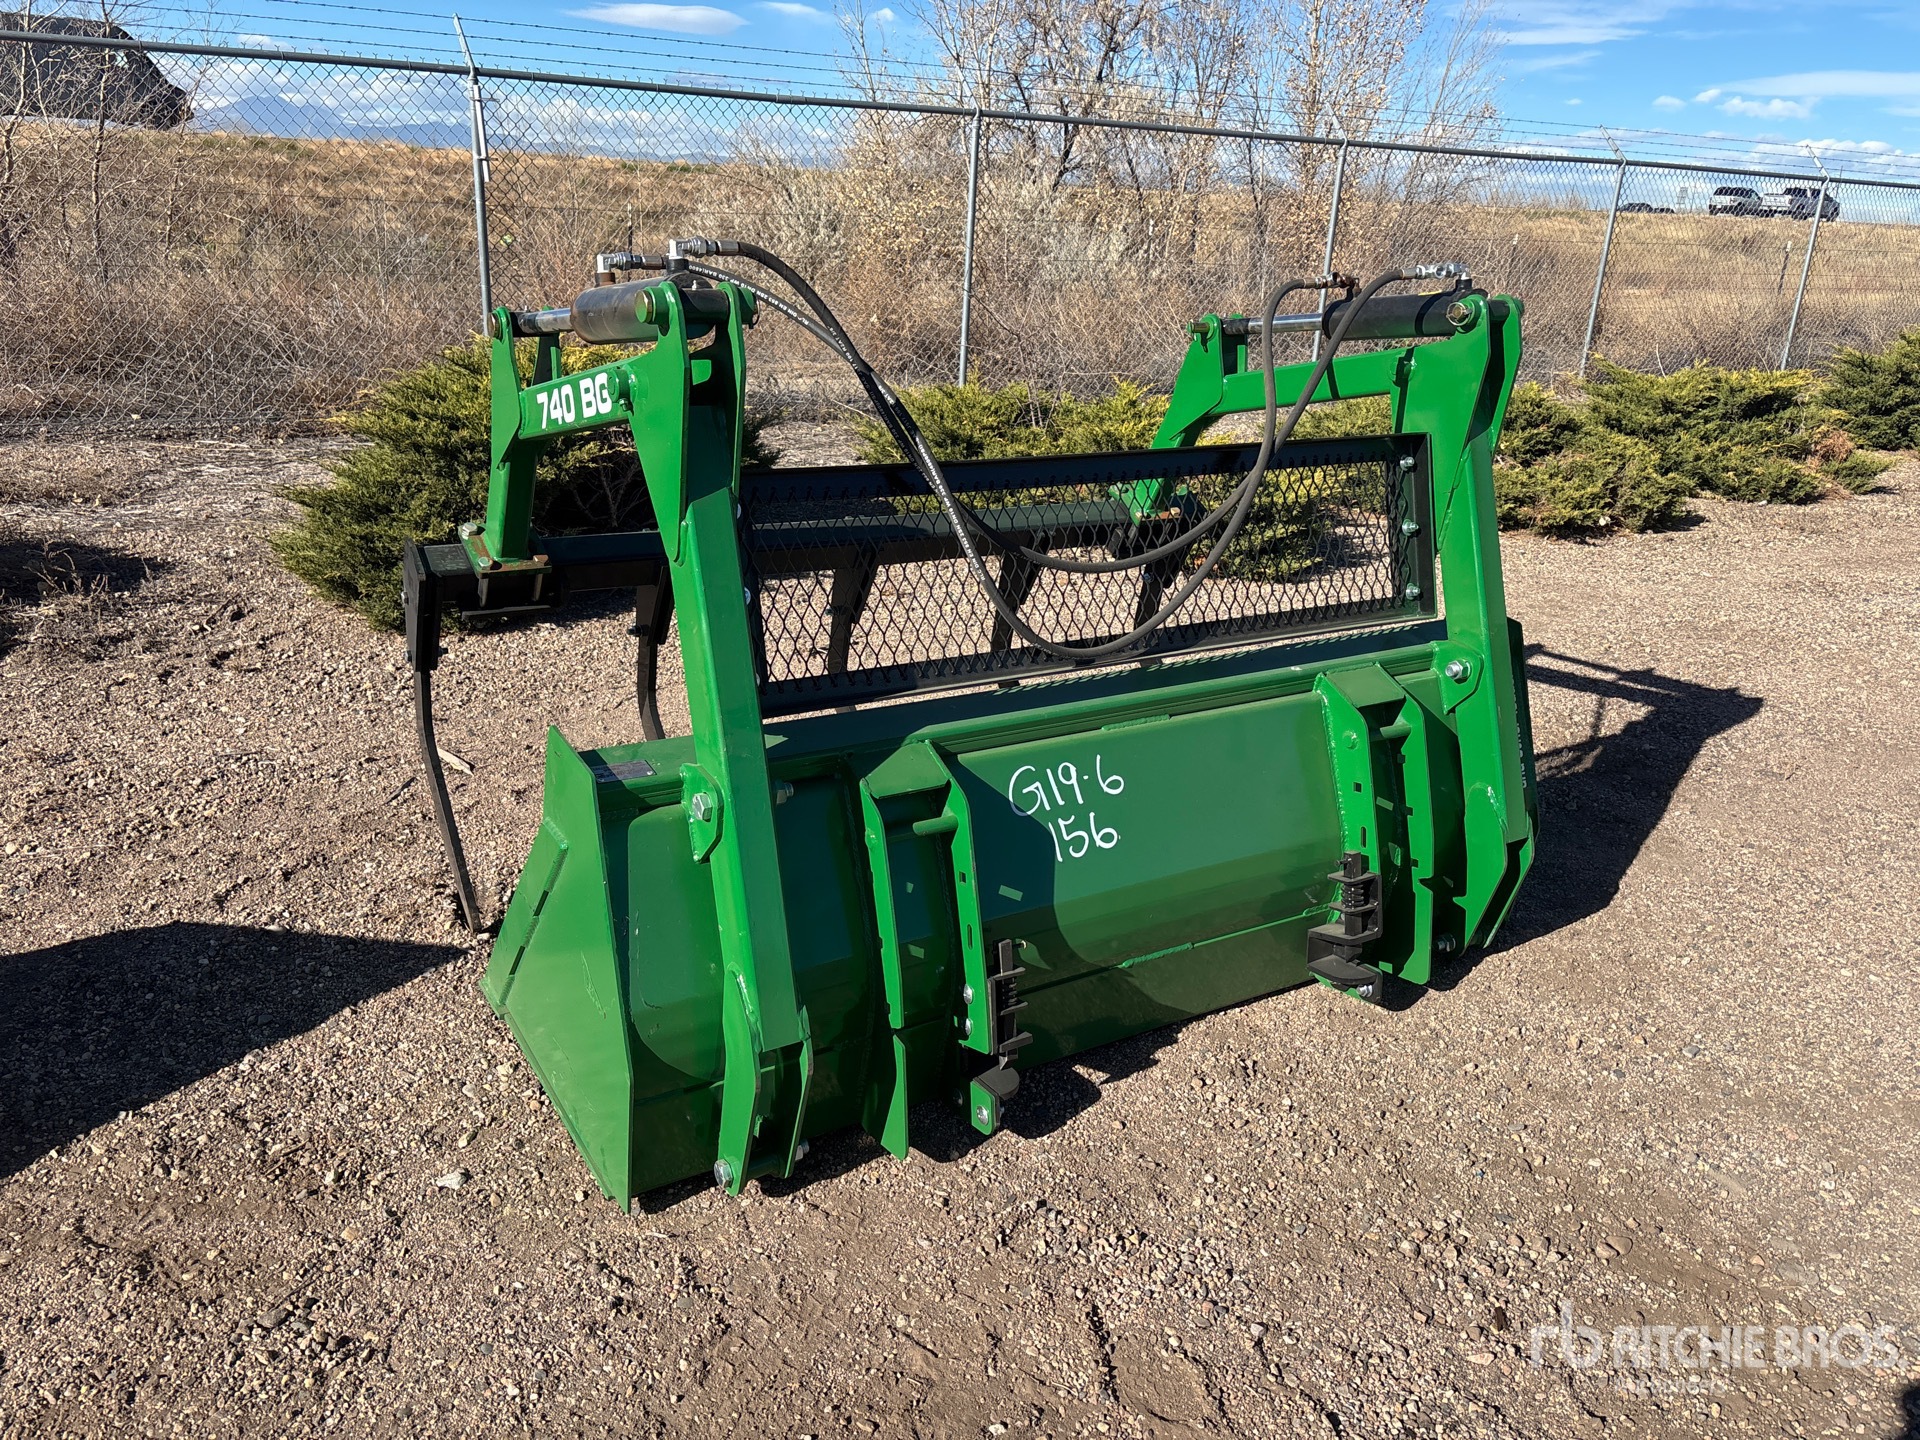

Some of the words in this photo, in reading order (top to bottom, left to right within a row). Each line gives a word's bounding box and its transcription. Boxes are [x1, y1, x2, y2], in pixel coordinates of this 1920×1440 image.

[845, 352, 853, 362] 100
[536, 383, 576, 430] 740
[579, 372, 613, 419] BG
[938, 484, 946, 496] 330
[943, 497, 951, 508] WP
[961, 537, 970, 548] 853
[966, 548, 974, 558] EN
[971, 558, 980, 569] DIN
